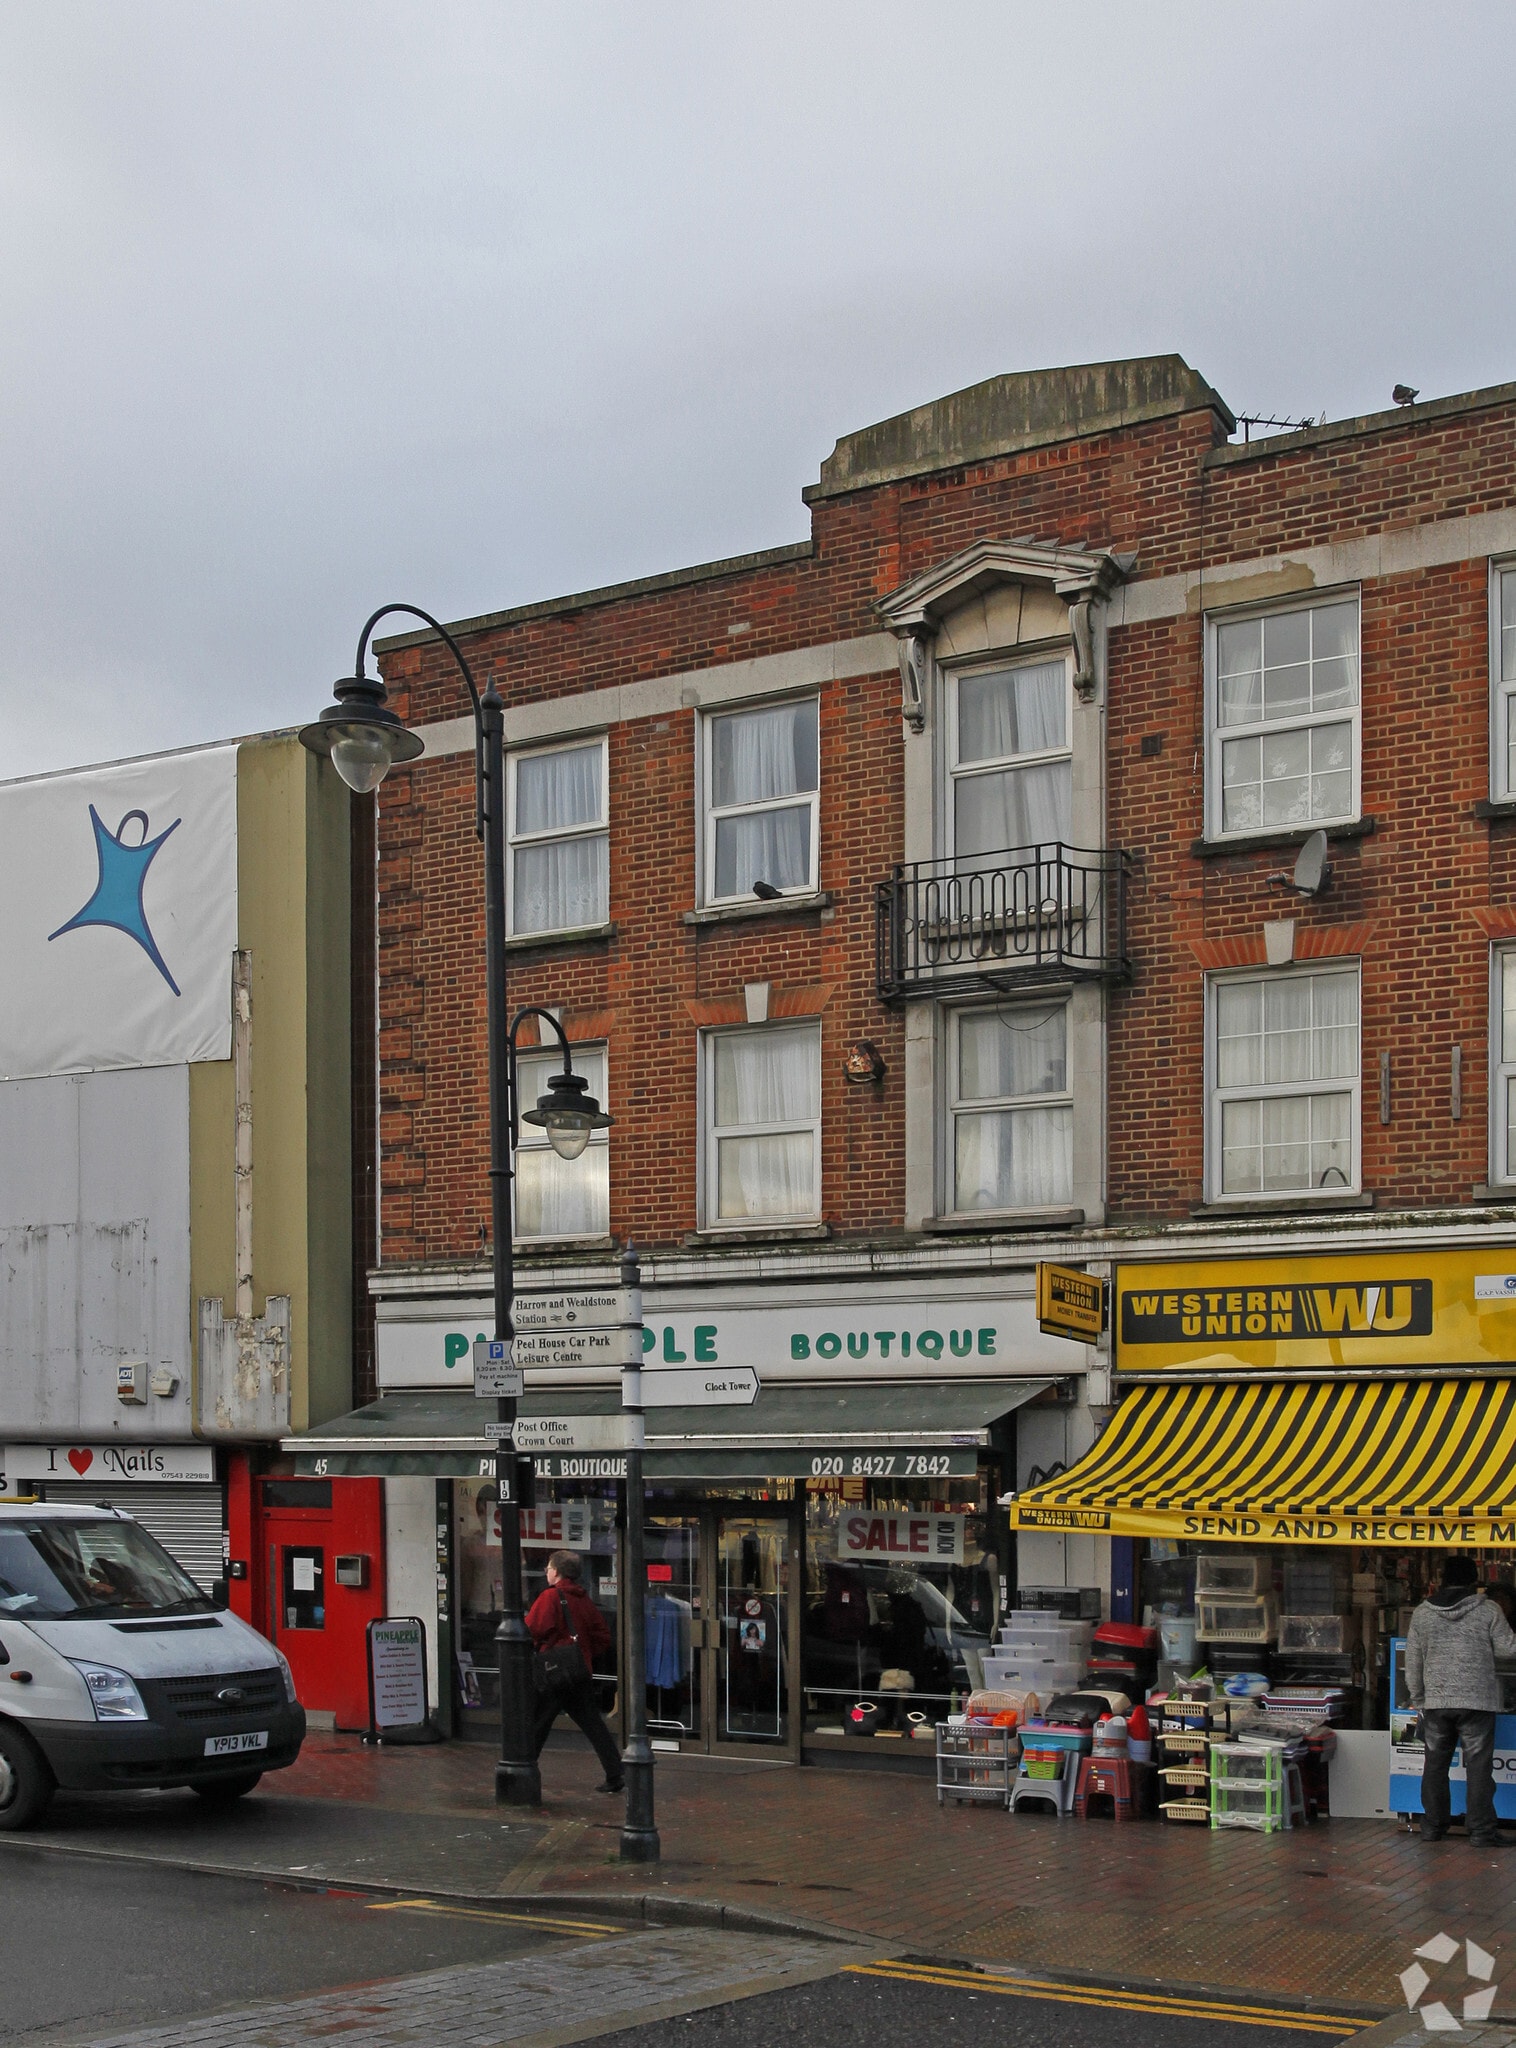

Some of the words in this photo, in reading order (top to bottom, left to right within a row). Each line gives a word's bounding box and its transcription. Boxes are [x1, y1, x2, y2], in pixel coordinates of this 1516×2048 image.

[1052, 1275, 1092, 1297] WESTERN
[516, 1301, 547, 1310] Harrow
[549, 1298, 564, 1308] and
[567, 1296, 616, 1307] Wealdstone
[1064, 1291, 1092, 1309] UNION
[1131, 1291, 1292, 1316] WESTERN
[1057, 1306, 1073, 1317] MONEY
[1075, 1310, 1097, 1323] TRANSFER
[1312, 1286, 1412, 1332] WU
[516, 1314, 547, 1324] Station
[1182, 1313, 1292, 1336] UNION
[517, 1339, 535, 1349] Peel
[539, 1338, 566, 1348] House
[569, 1337, 585, 1347] Car
[589, 1335, 610, 1346] Park
[791, 1328, 997, 1360] BOUTIQUE
[517, 1353, 550, 1363] Leisure
[553, 1351, 582, 1362] Centre
[119, 1369, 132, 1379] ADT
[705, 1381, 727, 1392] Clock
[728, 1381, 751, 1391] Tower
[517, 1421, 537, 1431] Post
[540, 1421, 568, 1431] Office
[517, 1436, 546, 1446] Crown
[548, 1435, 574, 1446] Court
[46, 1448, 58, 1472] I
[103, 1448, 165, 1478] Nails
[314, 1458, 328, 1475] 45
[560, 1458, 627, 1476] BOUTIQUE
[811, 1457, 844, 1475] 020
[852, 1456, 896, 1475] 8427
[905, 1455, 950, 1475] 7842
[568, 1511, 584, 1522] ON
[1021, 1509, 1071, 1519] WESTERN
[1036, 1517, 1071, 1525] UNION
[1076, 1512, 1105, 1527] WU
[568, 1523, 584, 1542] NOW
[847, 1517, 930, 1553] SALE
[937, 1521, 955, 1533] ON
[1183, 1516, 1261, 1536] SEND
[1271, 1519, 1338, 1539] AND
[1350, 1522, 1476, 1542] RECEIVE
[937, 1534, 955, 1555] NOW
[375, 1630, 419, 1641] PINEAPPLE
[214, 1737, 239, 1752] YP13
[242, 1734, 262, 1749] VKL
